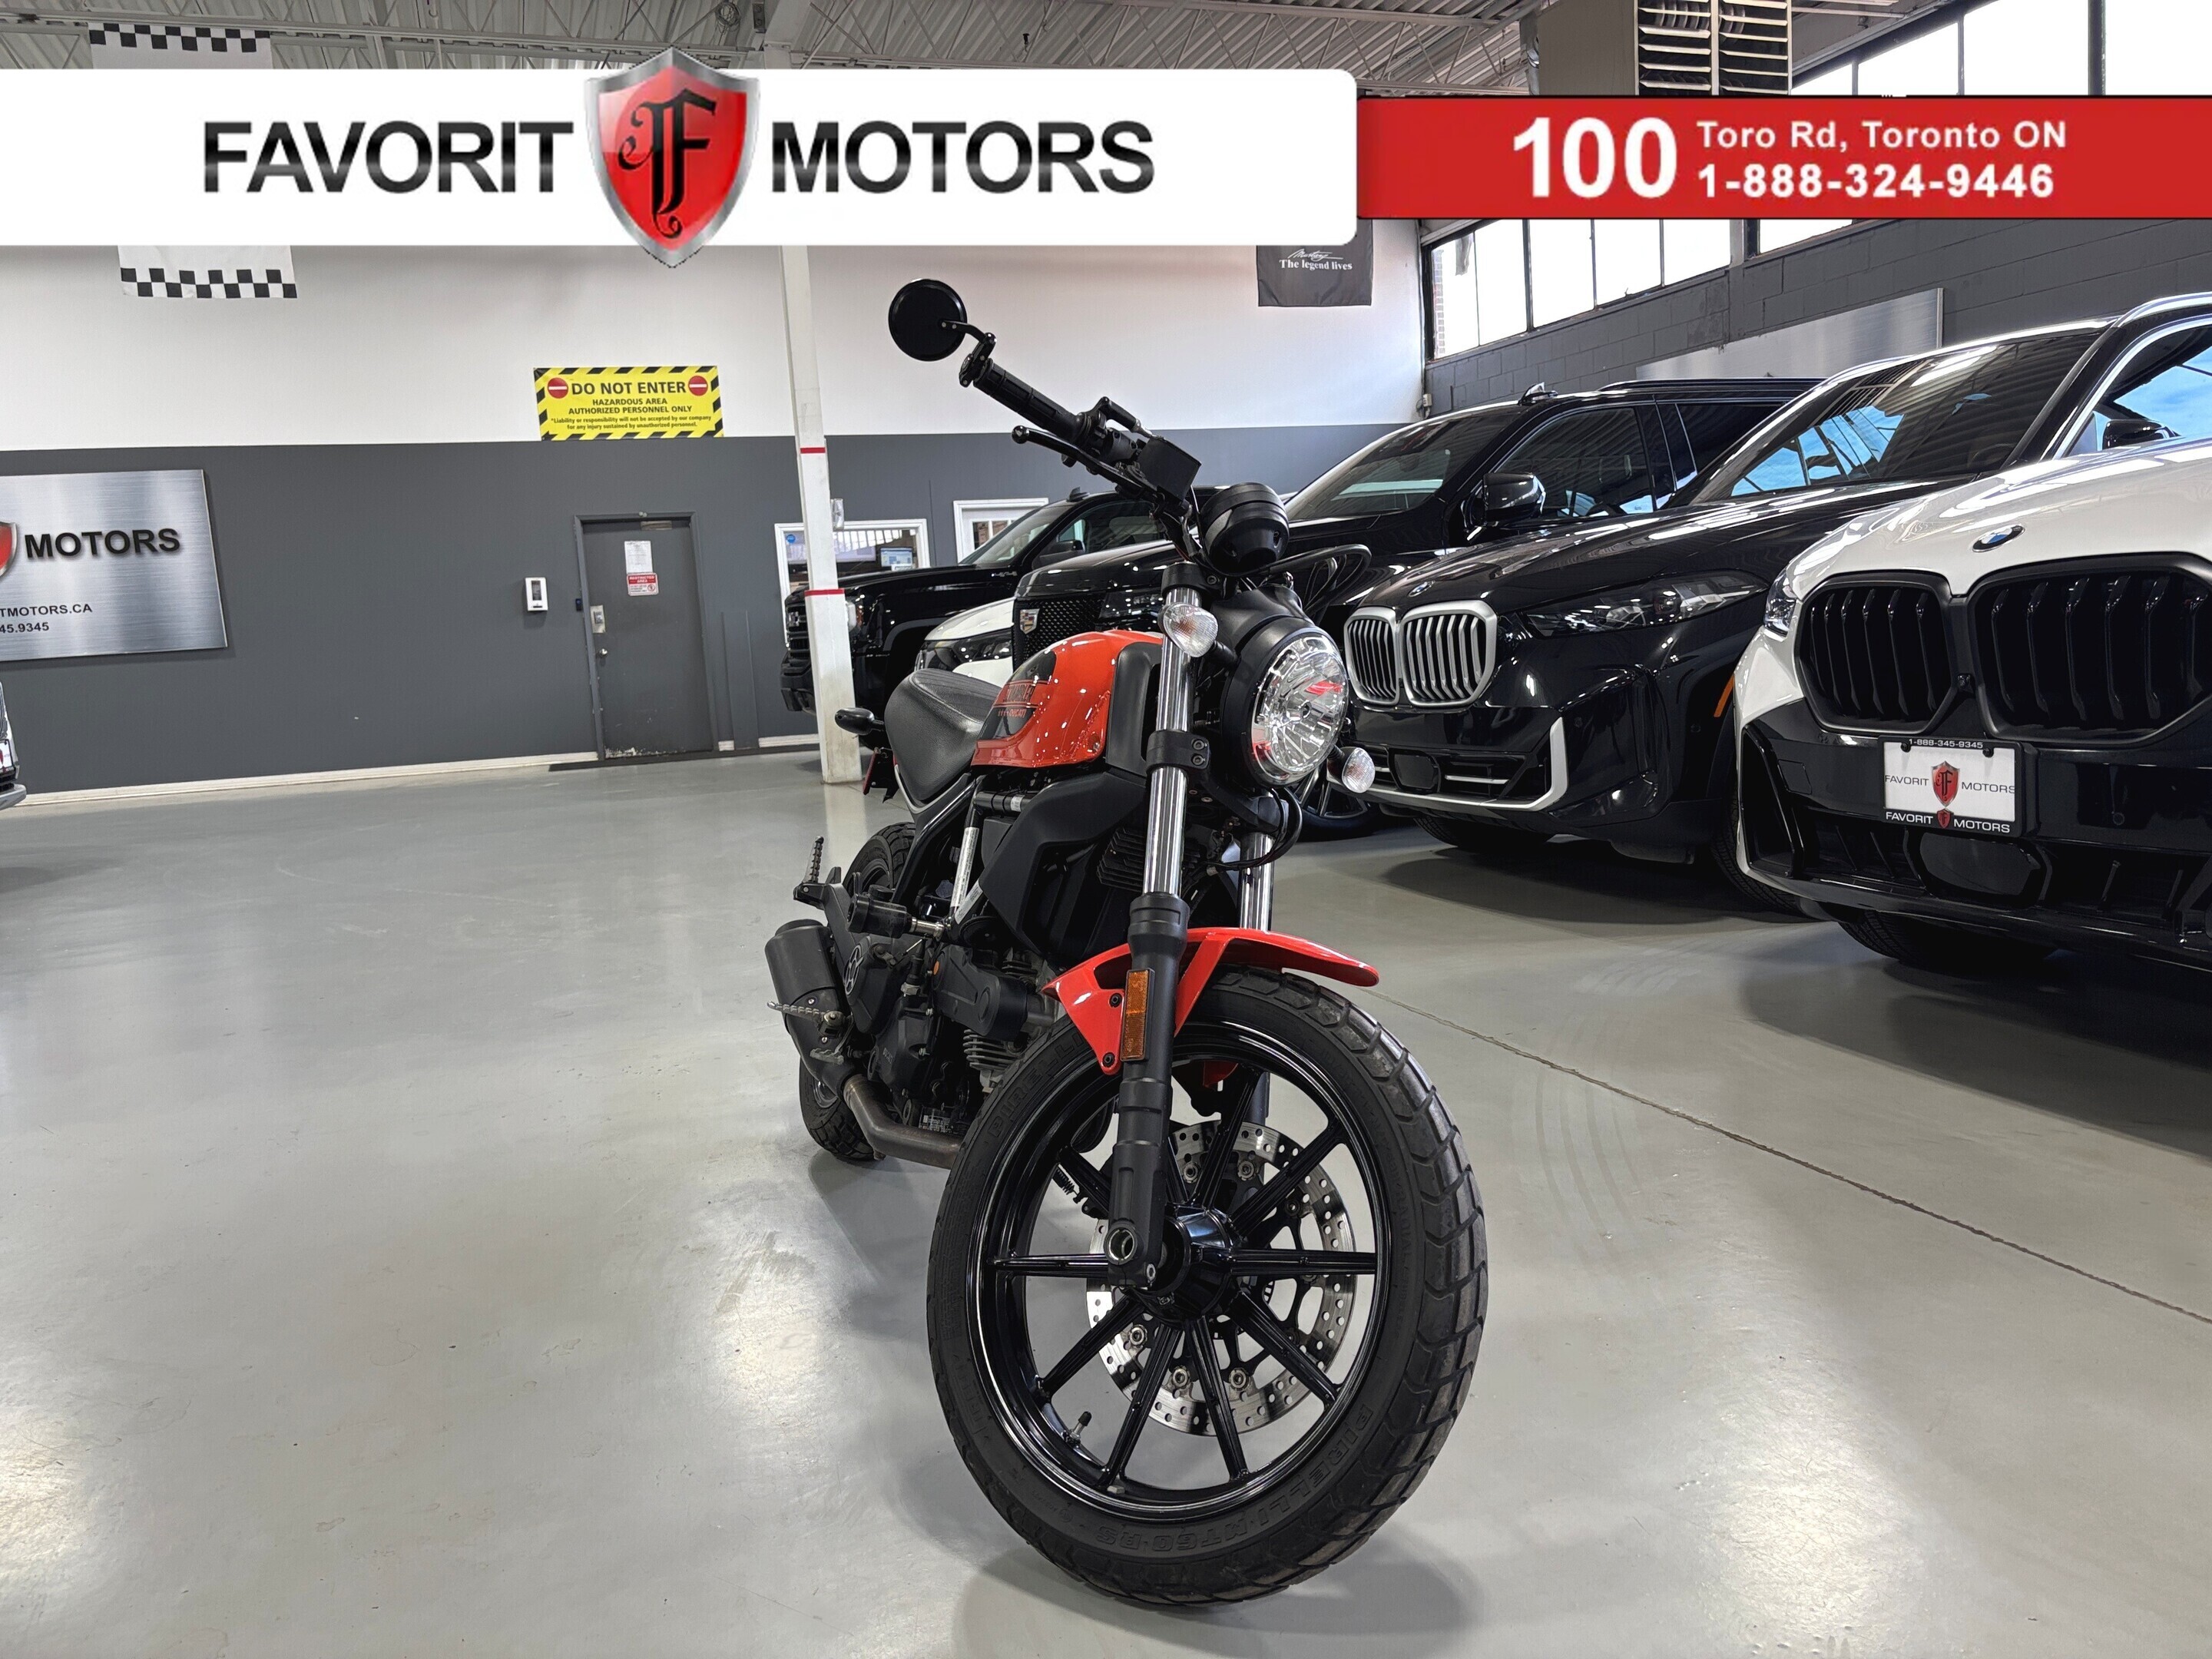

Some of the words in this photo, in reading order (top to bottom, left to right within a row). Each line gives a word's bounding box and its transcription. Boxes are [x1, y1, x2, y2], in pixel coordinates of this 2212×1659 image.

[1279, 259, 1299, 268] The
[1301, 259, 1330, 271] legend
[1332, 261, 1353, 270] lives
[571, 382, 595, 395] DO
[601, 382, 632, 395] NOT
[637, 381, 687, 394] ENTER
[25, 528, 180, 558] MOTORS
[1908, 738, 1983, 749] 1-888-345-9345
[1885, 774, 1929, 786] FAVORIT
[1962, 781, 2015, 794] MOTORS
[1886, 811, 1934, 825] FAVORIT
[1953, 818, 2011, 833] MOTORS
[1255, 1403, 1374, 1527] PIRELLI
[1094, 1525, 1142, 1550] RS
